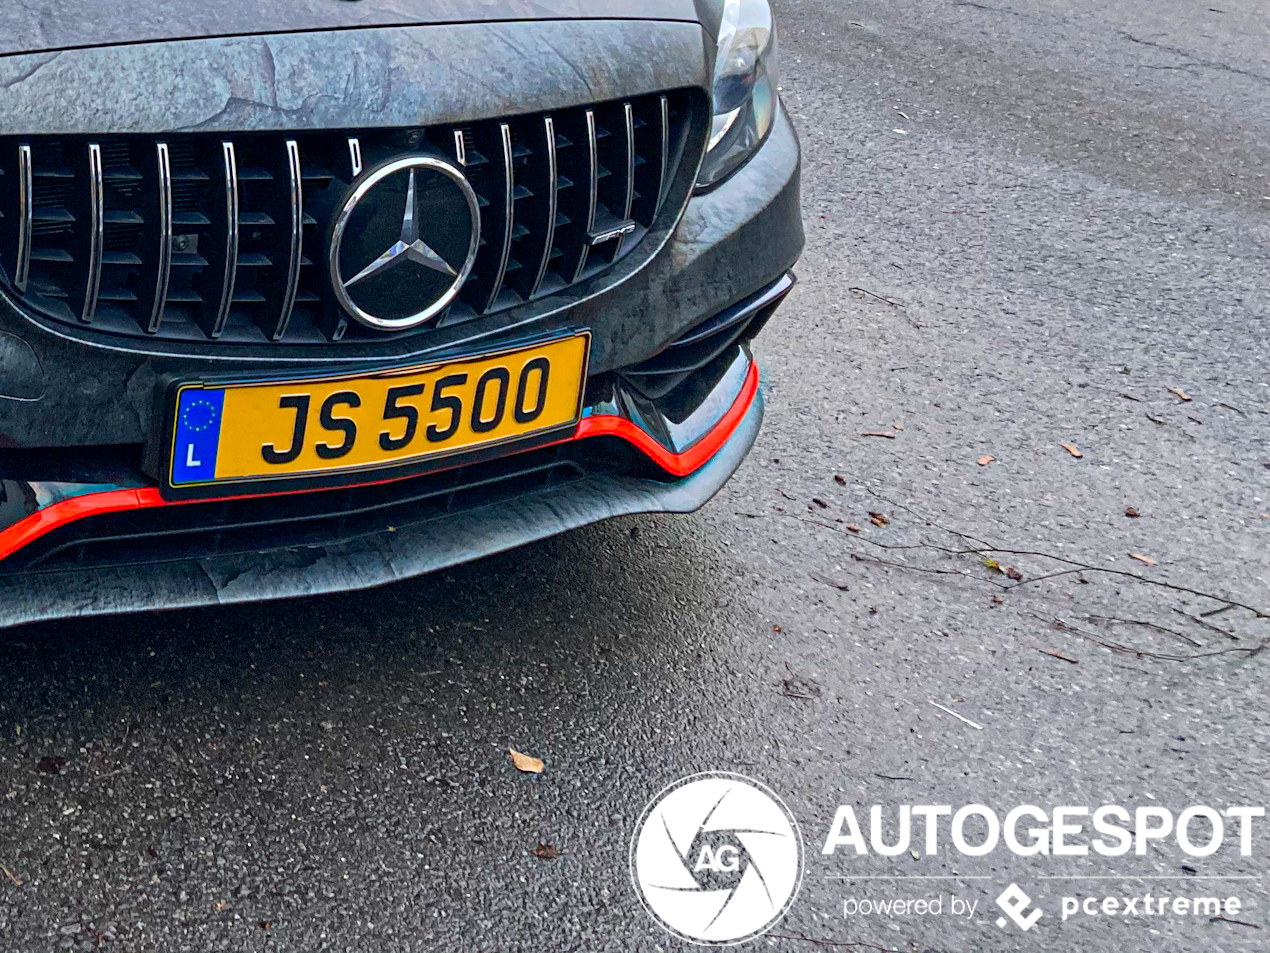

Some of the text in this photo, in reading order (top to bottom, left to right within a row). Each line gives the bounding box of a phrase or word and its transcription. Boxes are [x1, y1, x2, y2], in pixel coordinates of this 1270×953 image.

[261, 357, 550, 464] JS 5500
[186, 443, 201, 467] L
